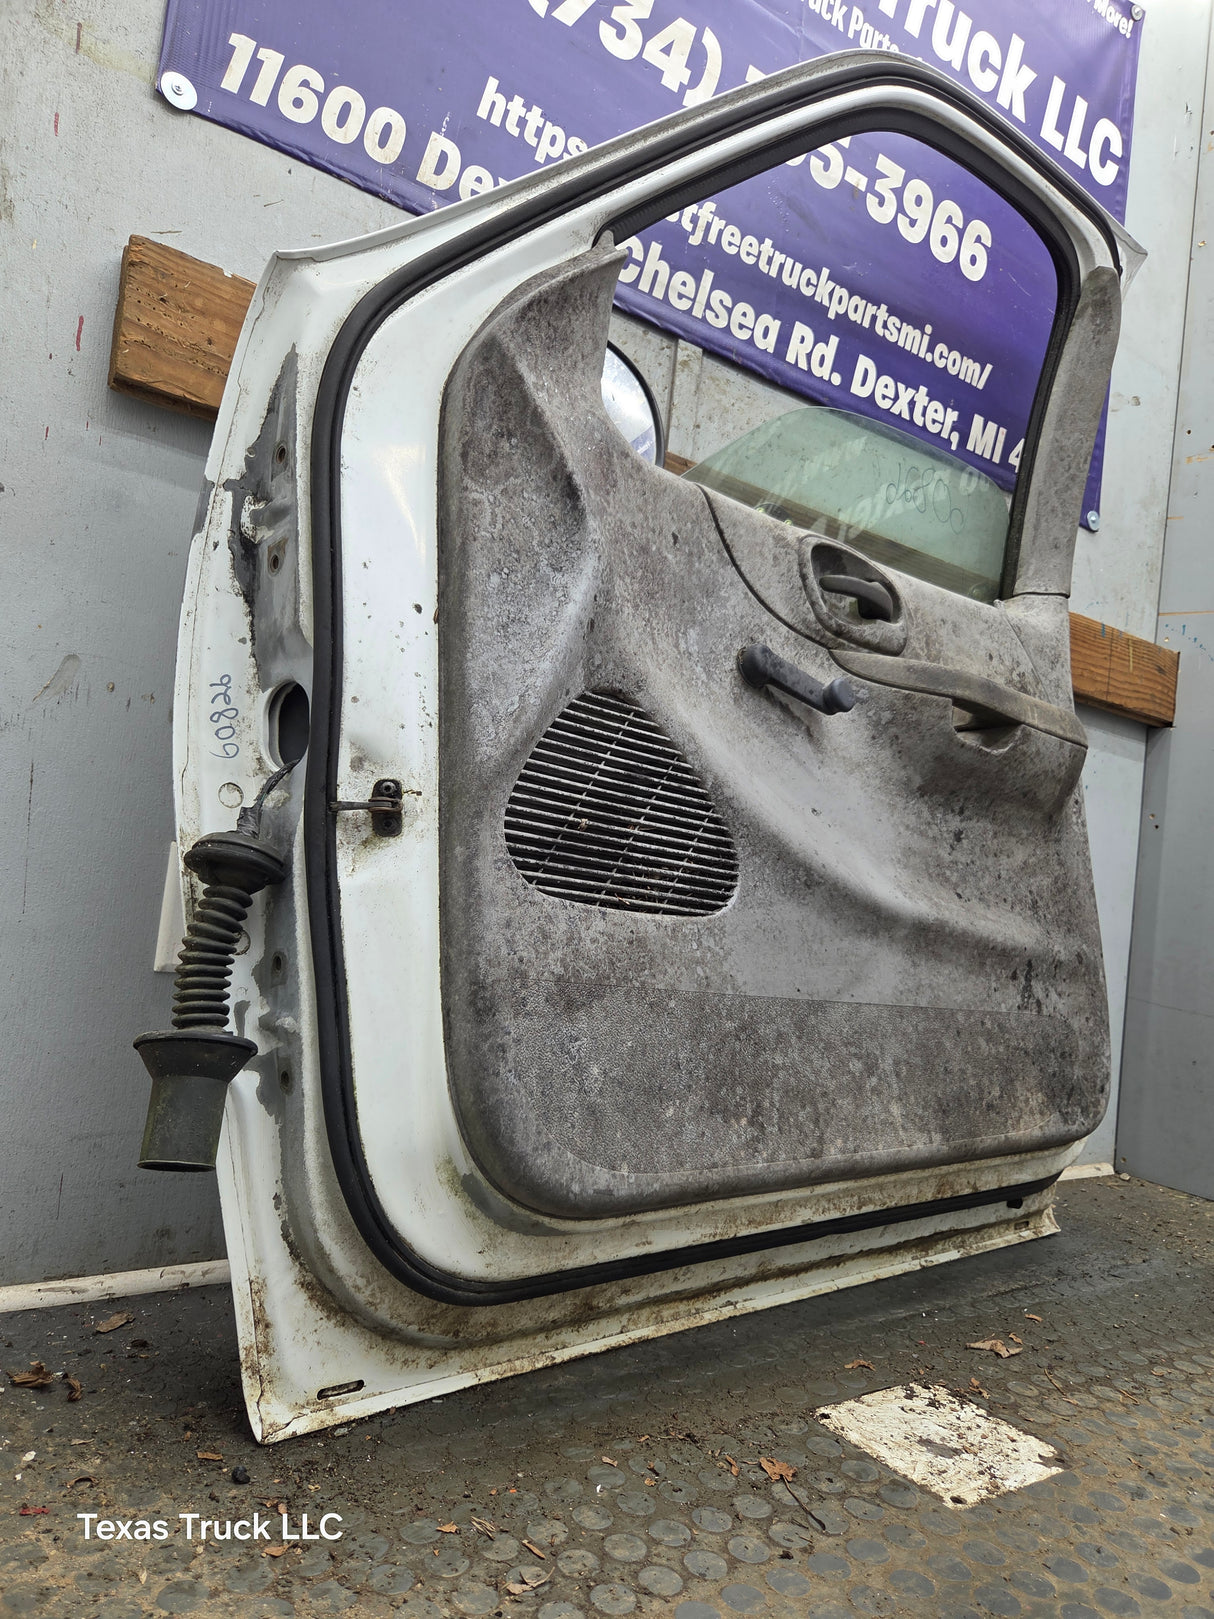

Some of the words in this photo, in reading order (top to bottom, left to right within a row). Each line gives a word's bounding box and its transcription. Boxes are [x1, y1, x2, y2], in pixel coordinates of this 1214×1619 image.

[1040, 76, 1124, 186] LLC
[220, 32, 407, 165] 11600
[615, 236, 781, 353] Chelsea
[785, 320, 842, 387] Rd.
[850, 353, 960, 451] Dexter,
[966, 415, 1008, 464] MI
[665, 202, 993, 390] tfreetruckpartsmi.com/
[209, 673, 240, 759] 60826
